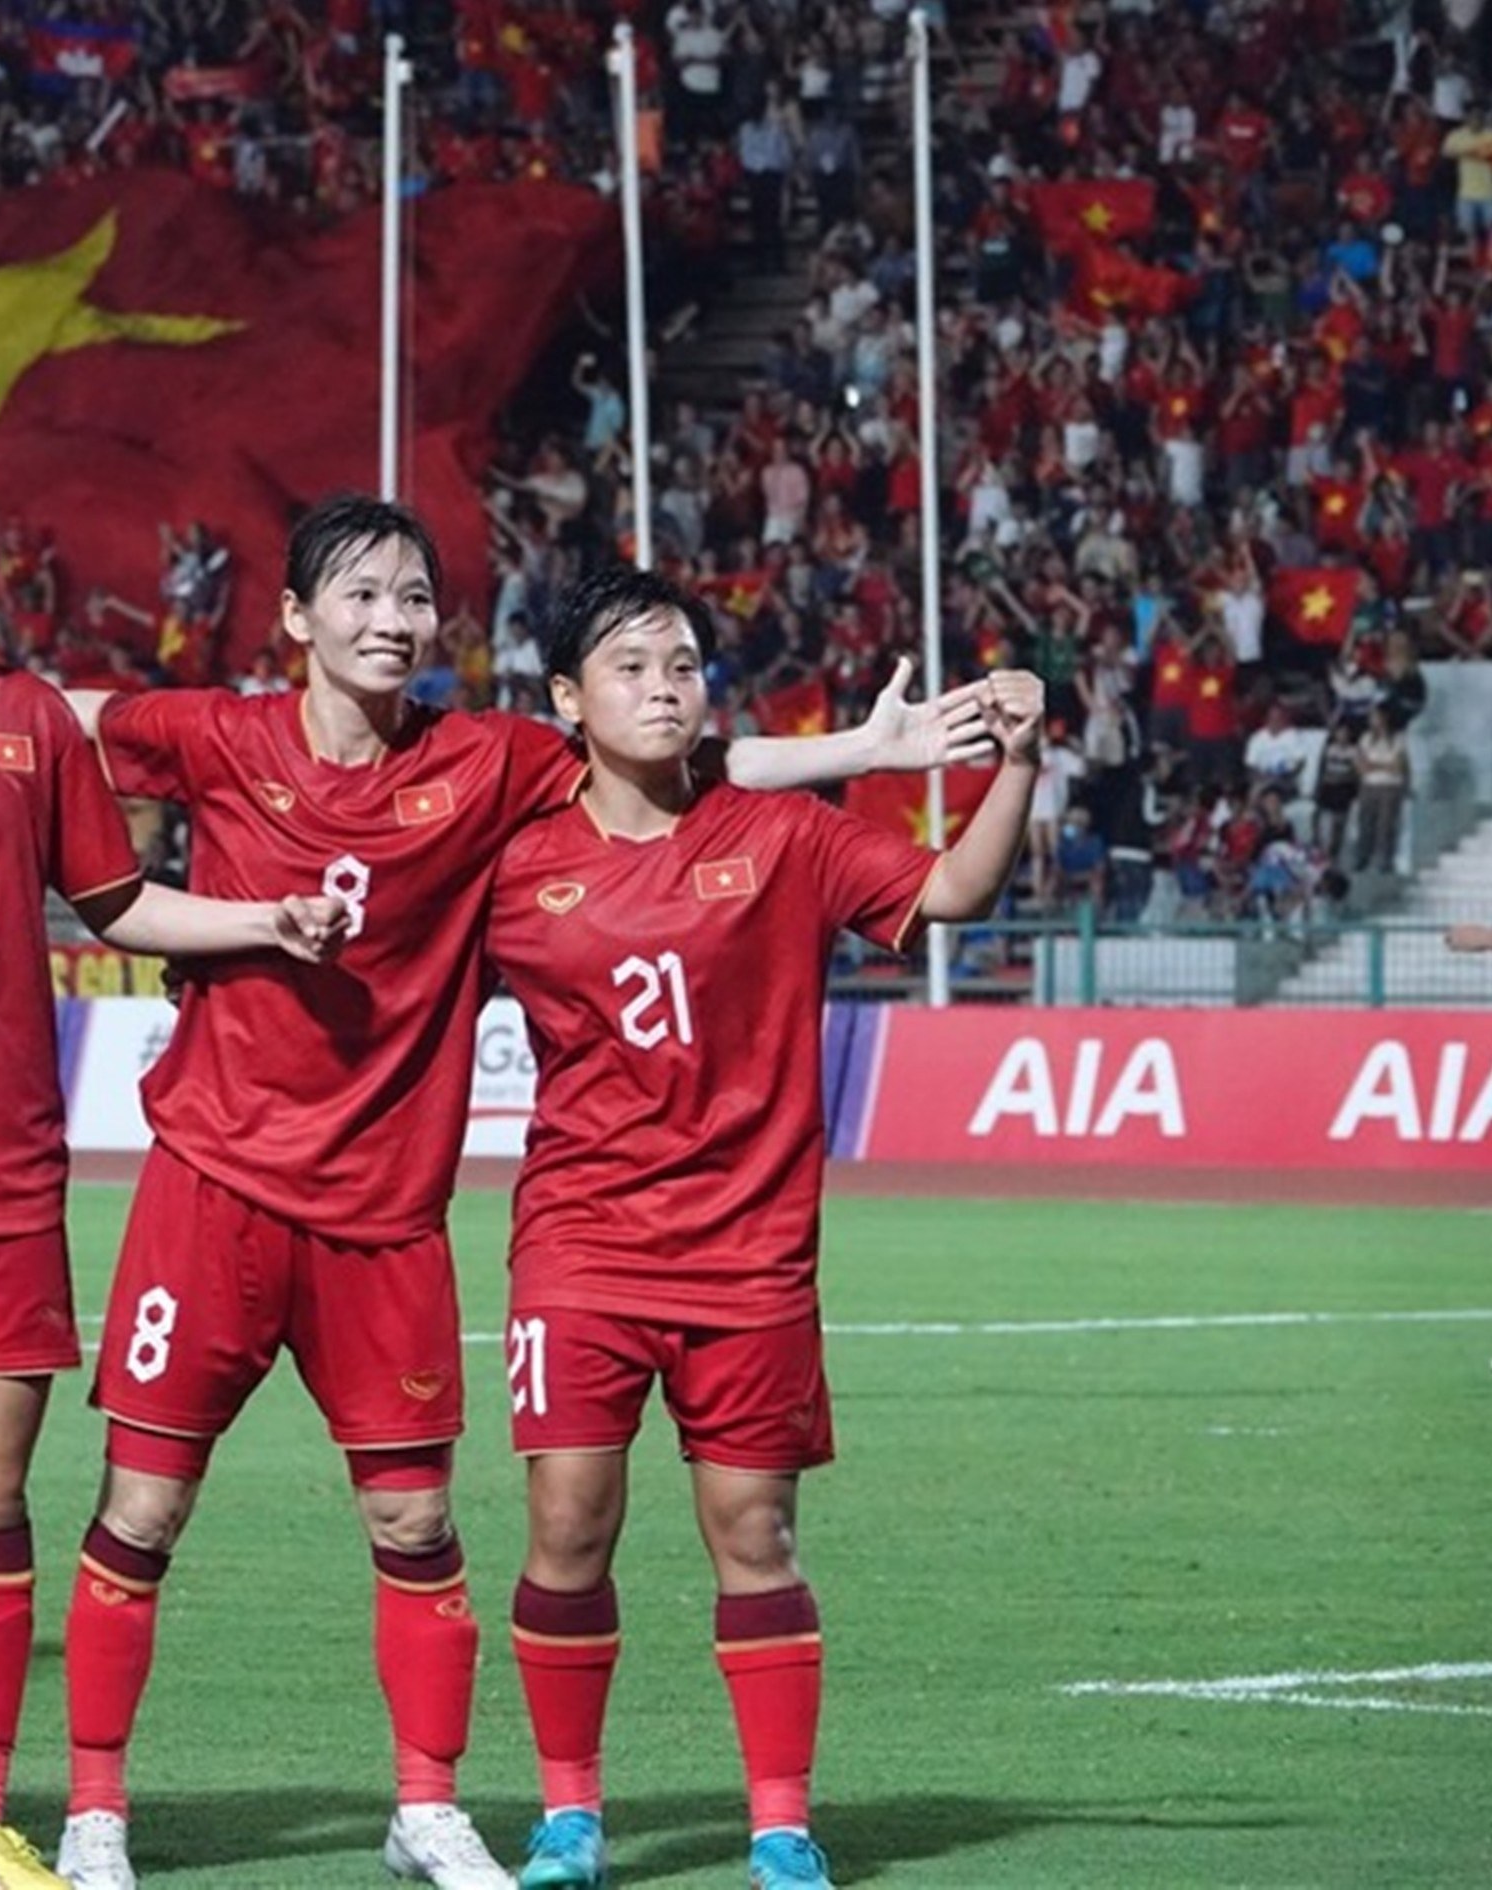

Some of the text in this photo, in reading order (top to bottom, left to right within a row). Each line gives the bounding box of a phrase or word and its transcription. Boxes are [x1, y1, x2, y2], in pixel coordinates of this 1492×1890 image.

[322, 853, 369, 939] 8
[612, 950, 693, 1049] 21
[967, 1036, 1187, 1138] AIA
[126, 1286, 178, 1383] 8
